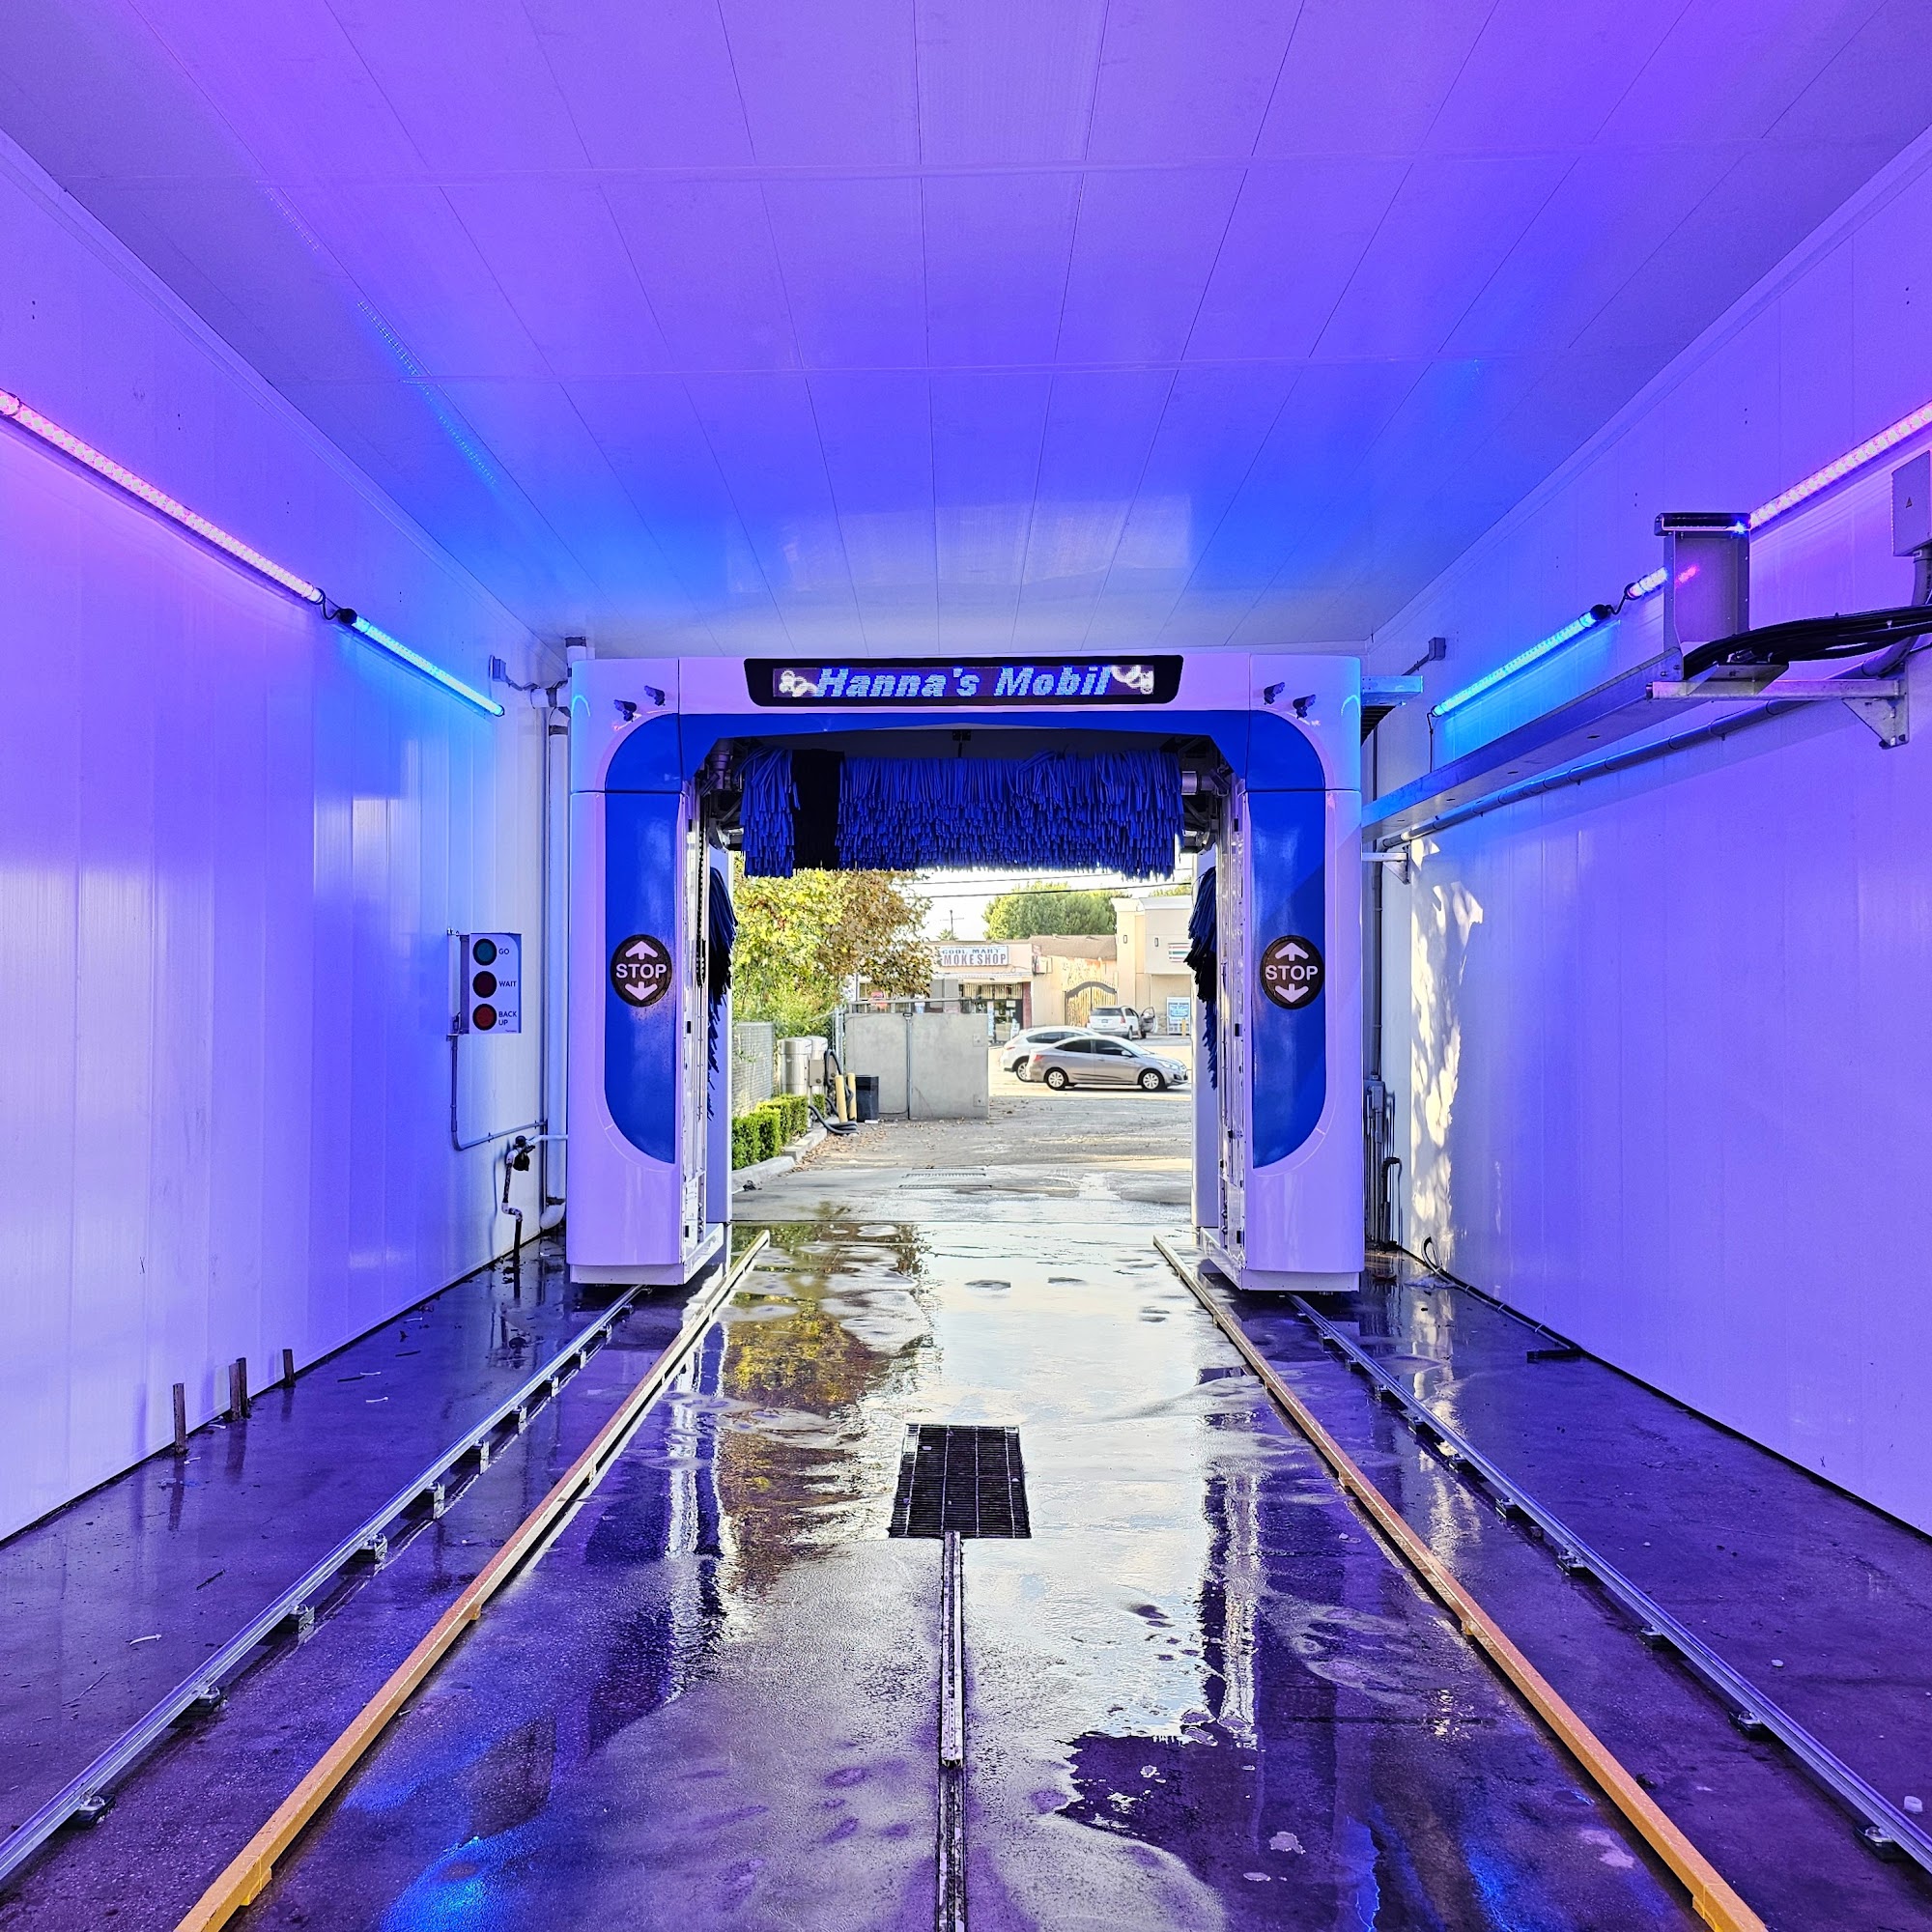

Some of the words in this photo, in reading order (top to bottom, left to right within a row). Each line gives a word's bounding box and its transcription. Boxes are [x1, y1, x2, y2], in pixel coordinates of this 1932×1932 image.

[816, 667, 979, 696] Hanna's
[994, 666, 1111, 696] Mobil
[944, 954, 974, 965] MOKE
[977, 953, 1007, 965] SHOP
[615, 963, 668, 979] STOP
[1264, 964, 1319, 980] STOP
